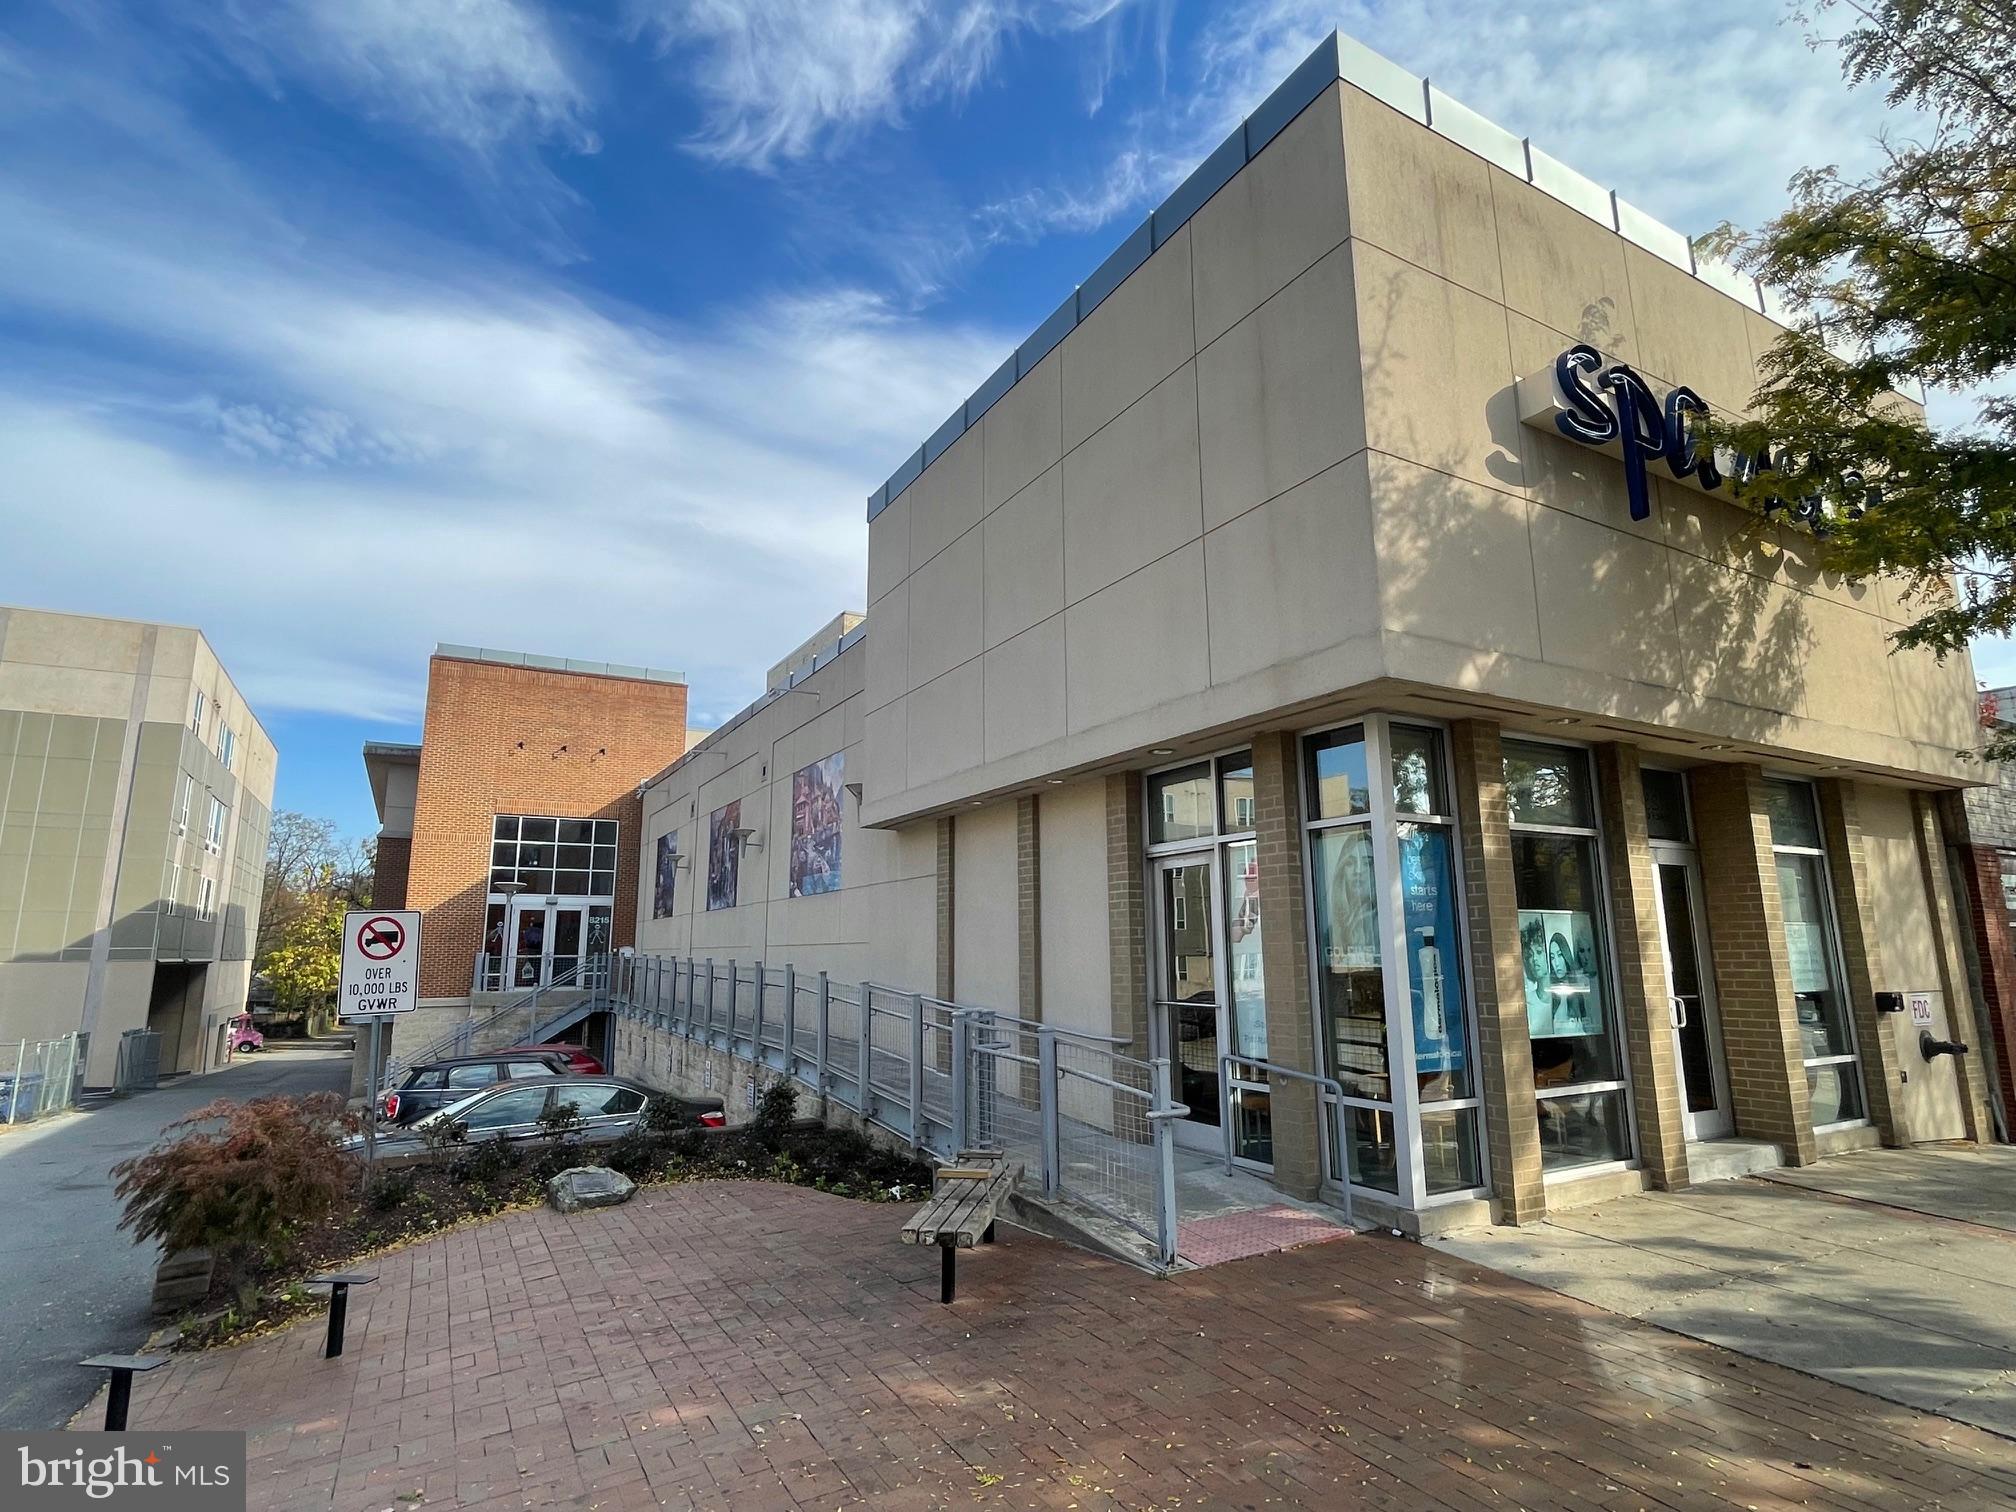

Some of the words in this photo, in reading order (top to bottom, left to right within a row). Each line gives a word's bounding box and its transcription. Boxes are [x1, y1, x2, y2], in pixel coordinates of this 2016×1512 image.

[1410, 884, 1438, 896] starts
[1412, 900, 1433, 911] here
[365, 967, 392, 980] OVER
[349, 982, 385, 996] 10,000
[389, 981, 408, 994] LBS
[358, 997, 397, 1011] GVWR
[1912, 999, 1931, 1019] FDC
